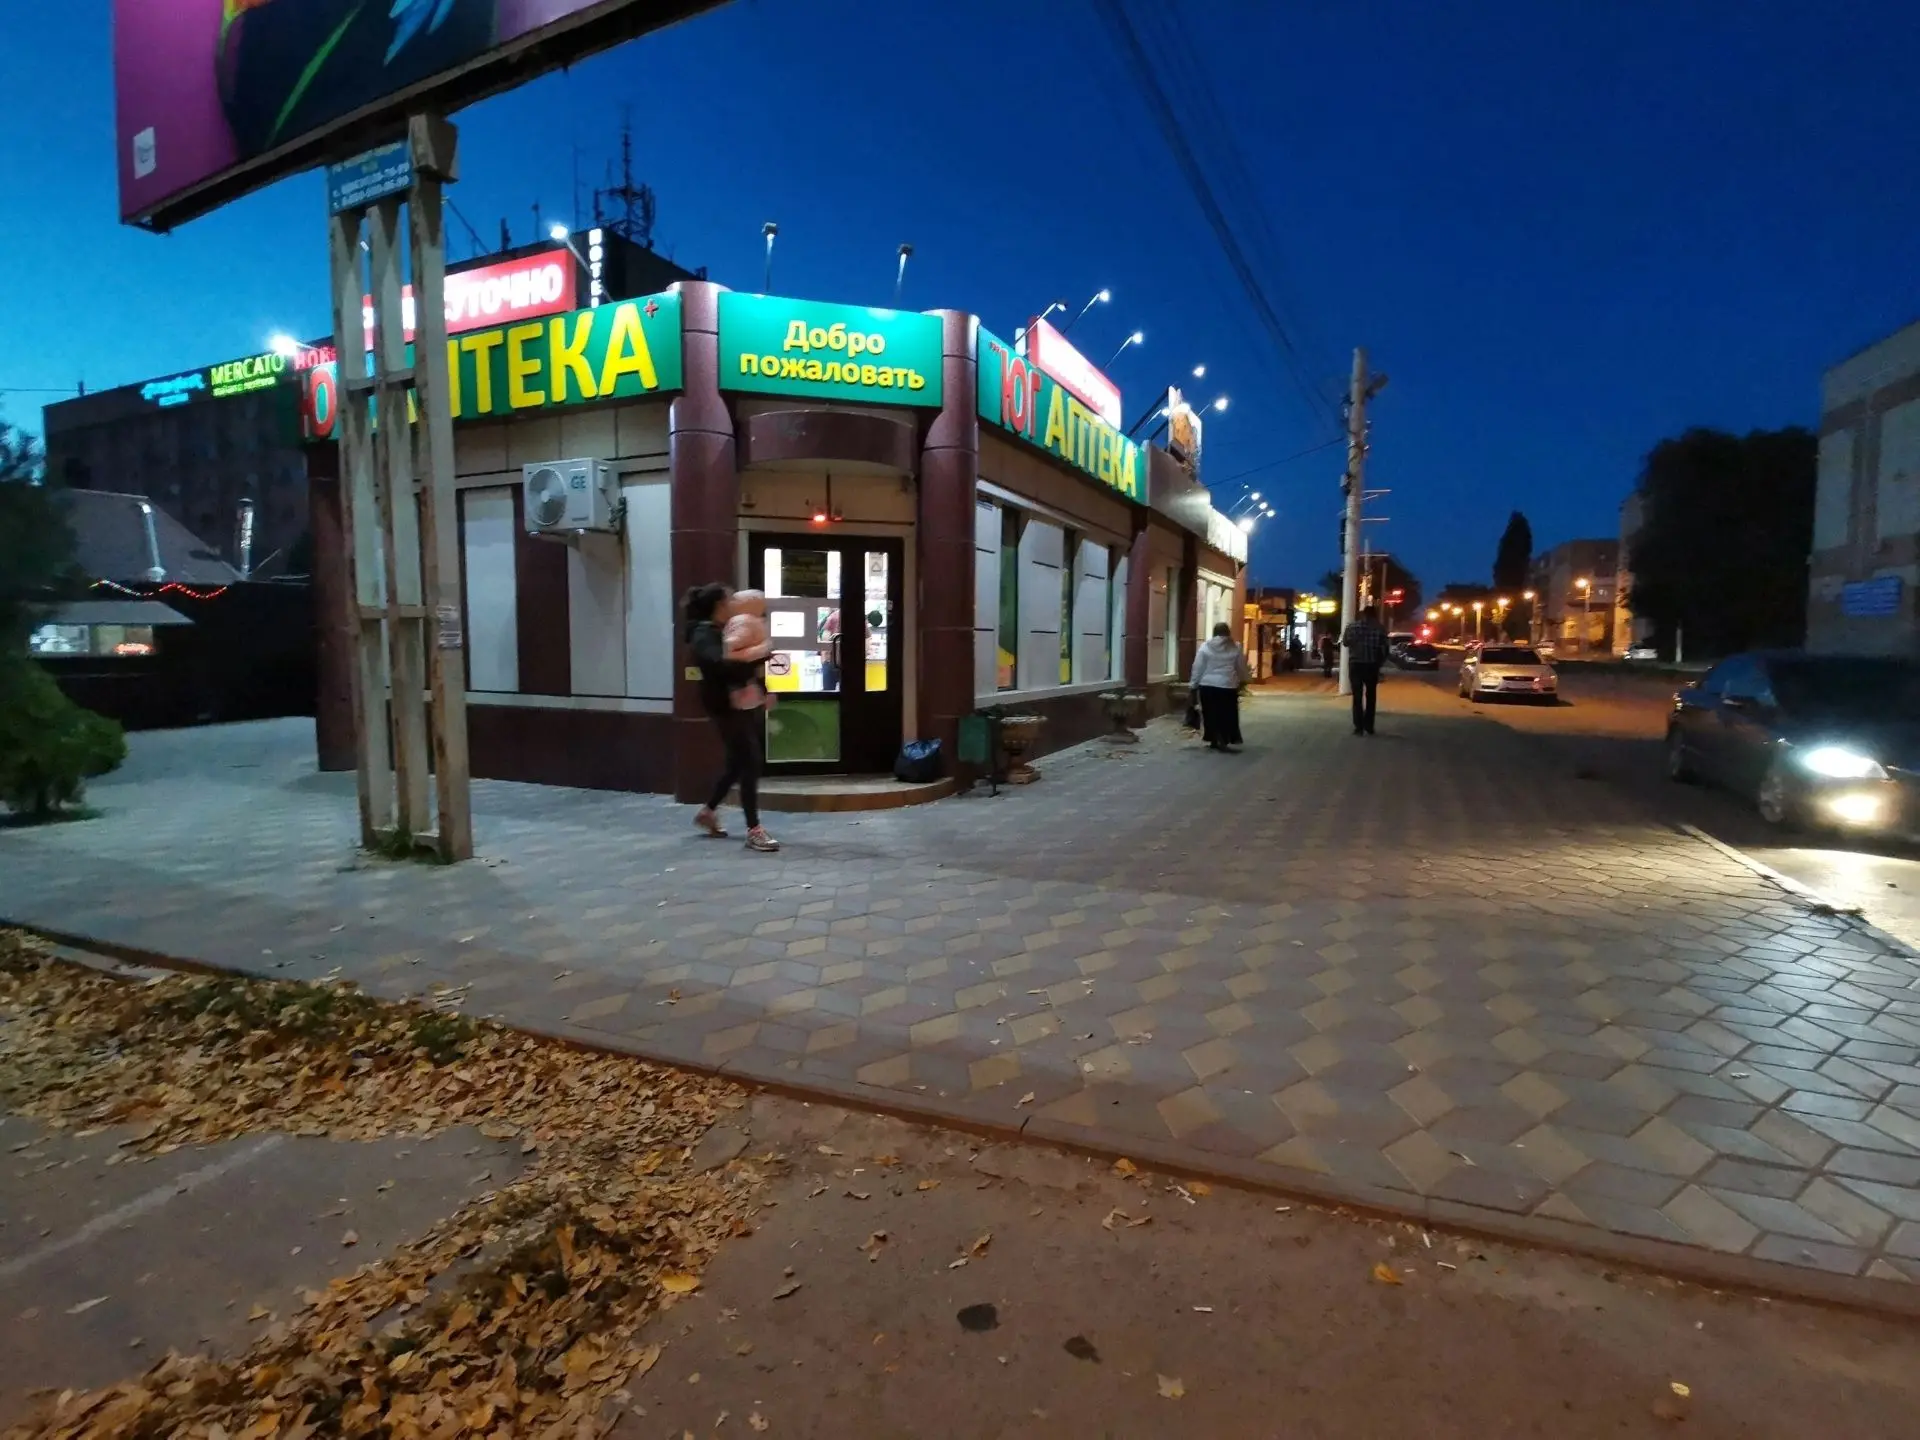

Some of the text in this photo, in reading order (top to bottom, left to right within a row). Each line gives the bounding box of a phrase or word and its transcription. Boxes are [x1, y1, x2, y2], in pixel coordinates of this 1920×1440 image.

[783, 320, 886, 358] Добро
[211, 352, 286, 387] MERCATO
[300, 302, 659, 439] Ю ТЕКА
[740, 353, 925, 390] пожаловать
[1000, 347, 1042, 439] ЮГ
[1043, 383, 1137, 498] АПТЕКА
